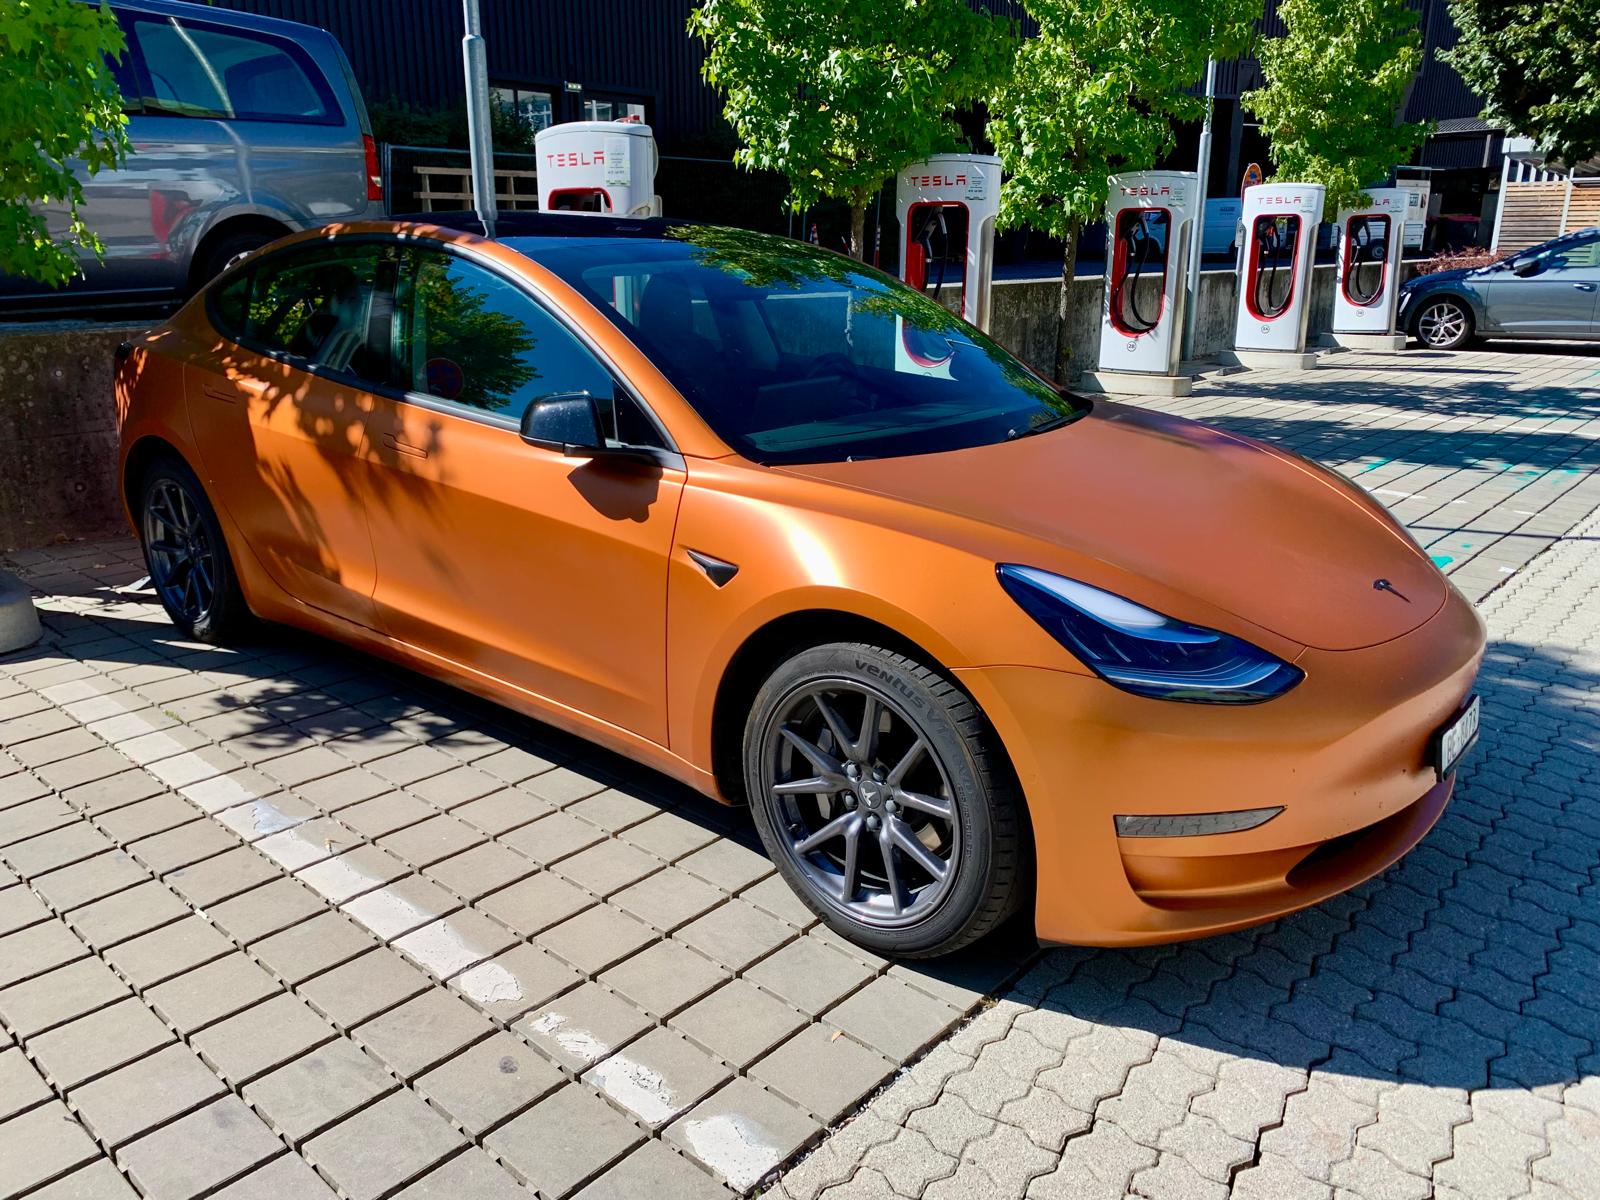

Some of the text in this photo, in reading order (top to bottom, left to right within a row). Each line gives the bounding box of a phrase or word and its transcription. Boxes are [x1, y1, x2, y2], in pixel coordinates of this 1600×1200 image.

[546, 151, 605, 168] TESLA
[911, 175, 966, 187] TESLA
[1120, 186, 1170, 197] TESLA
[1257, 196, 1302, 205] TESLA
